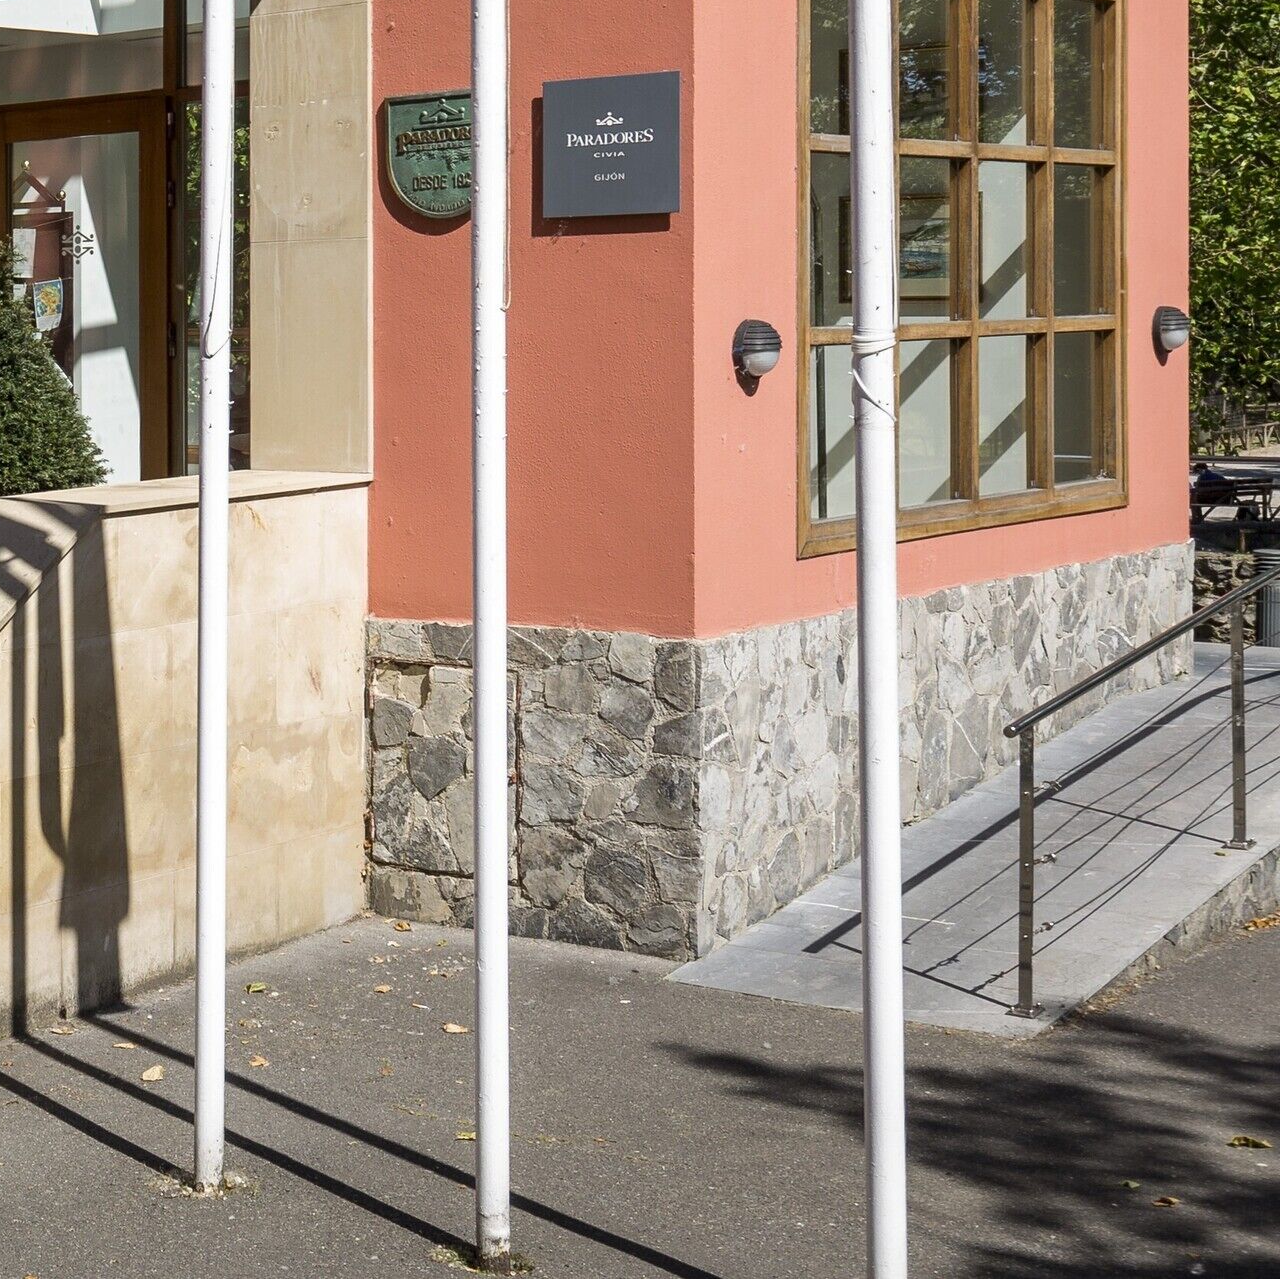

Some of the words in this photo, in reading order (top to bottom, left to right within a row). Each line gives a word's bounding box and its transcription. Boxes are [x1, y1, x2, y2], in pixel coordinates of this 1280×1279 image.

[396, 126, 471, 156] PARADOR
[566, 128, 654, 147] PARADORES
[412, 175, 448, 192] DESDE
[453, 171, 471, 189] 192
[594, 172, 625, 181] GIJÓN
